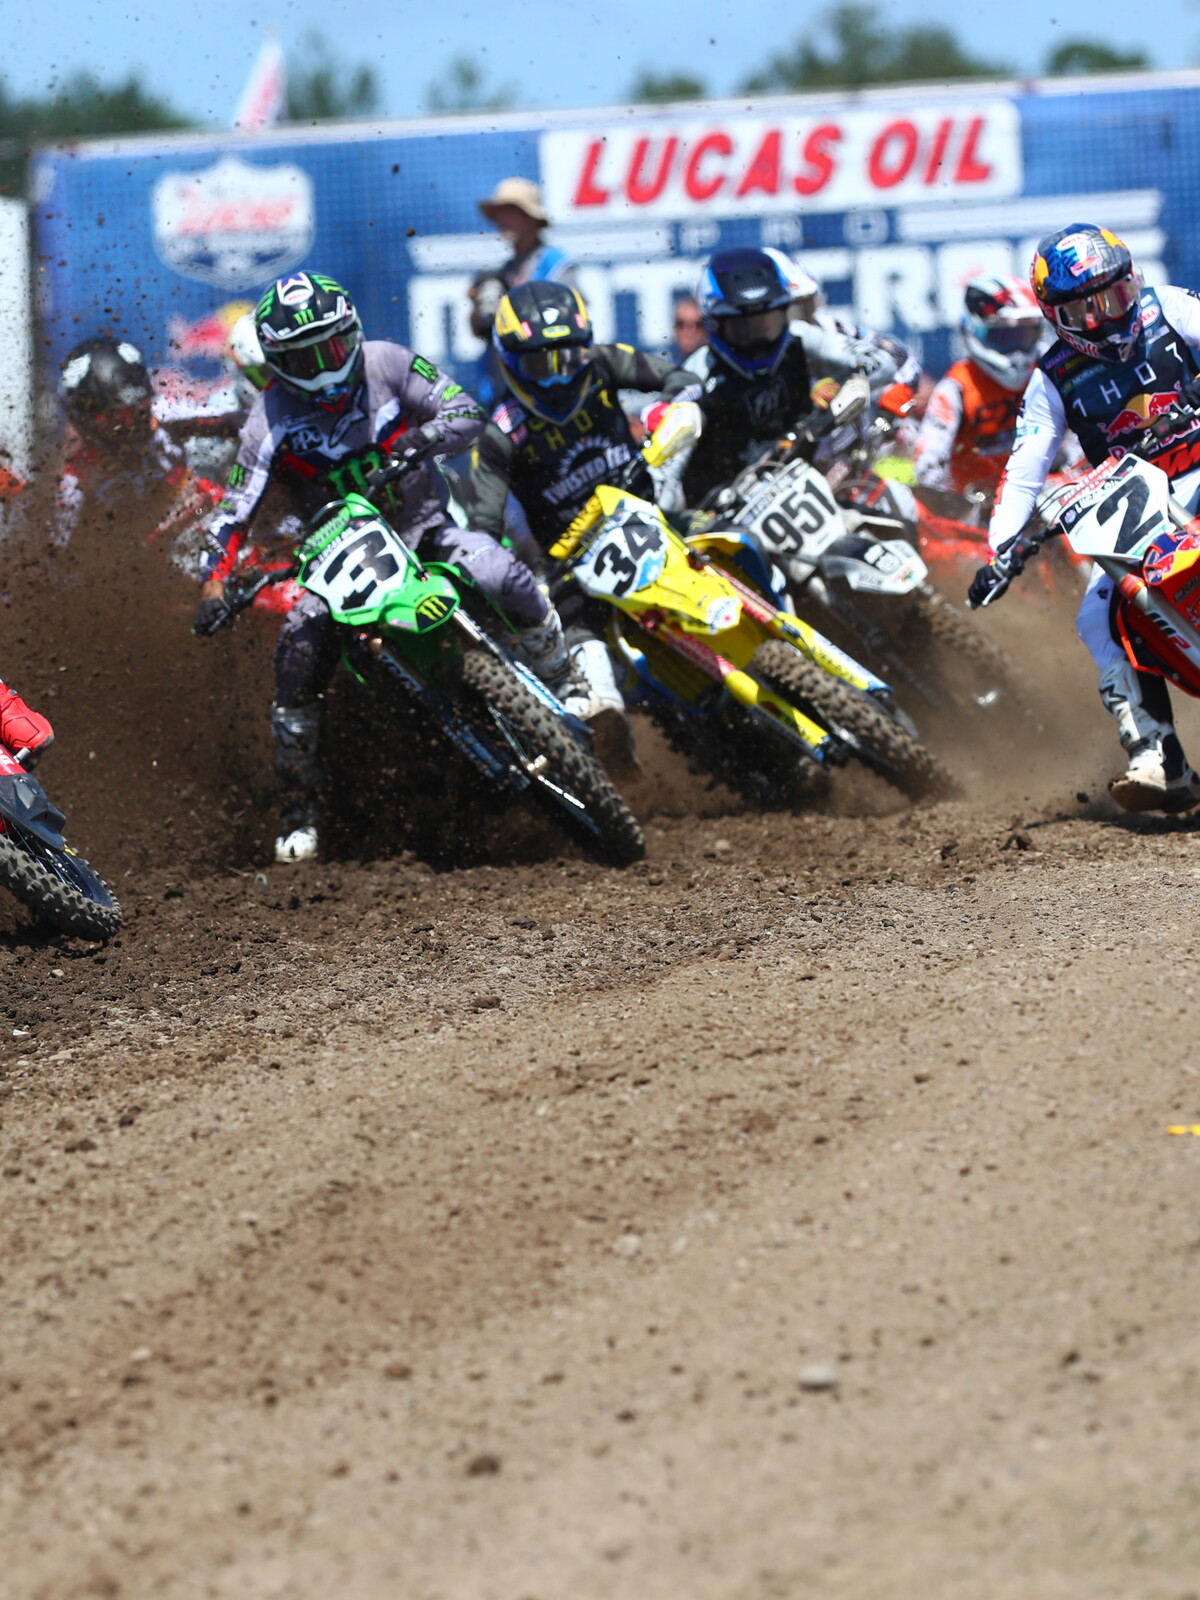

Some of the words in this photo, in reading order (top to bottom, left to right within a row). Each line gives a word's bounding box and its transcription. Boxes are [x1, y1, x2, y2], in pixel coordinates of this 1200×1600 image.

[574, 124, 842, 206] LUCAS
[868, 116, 992, 188] OIL
[541, 456, 607, 505] TWISTED
[761, 479, 835, 555] 951
[1096, 474, 1165, 554] 2
[324, 530, 400, 610] 3
[594, 514, 664, 597] 34
